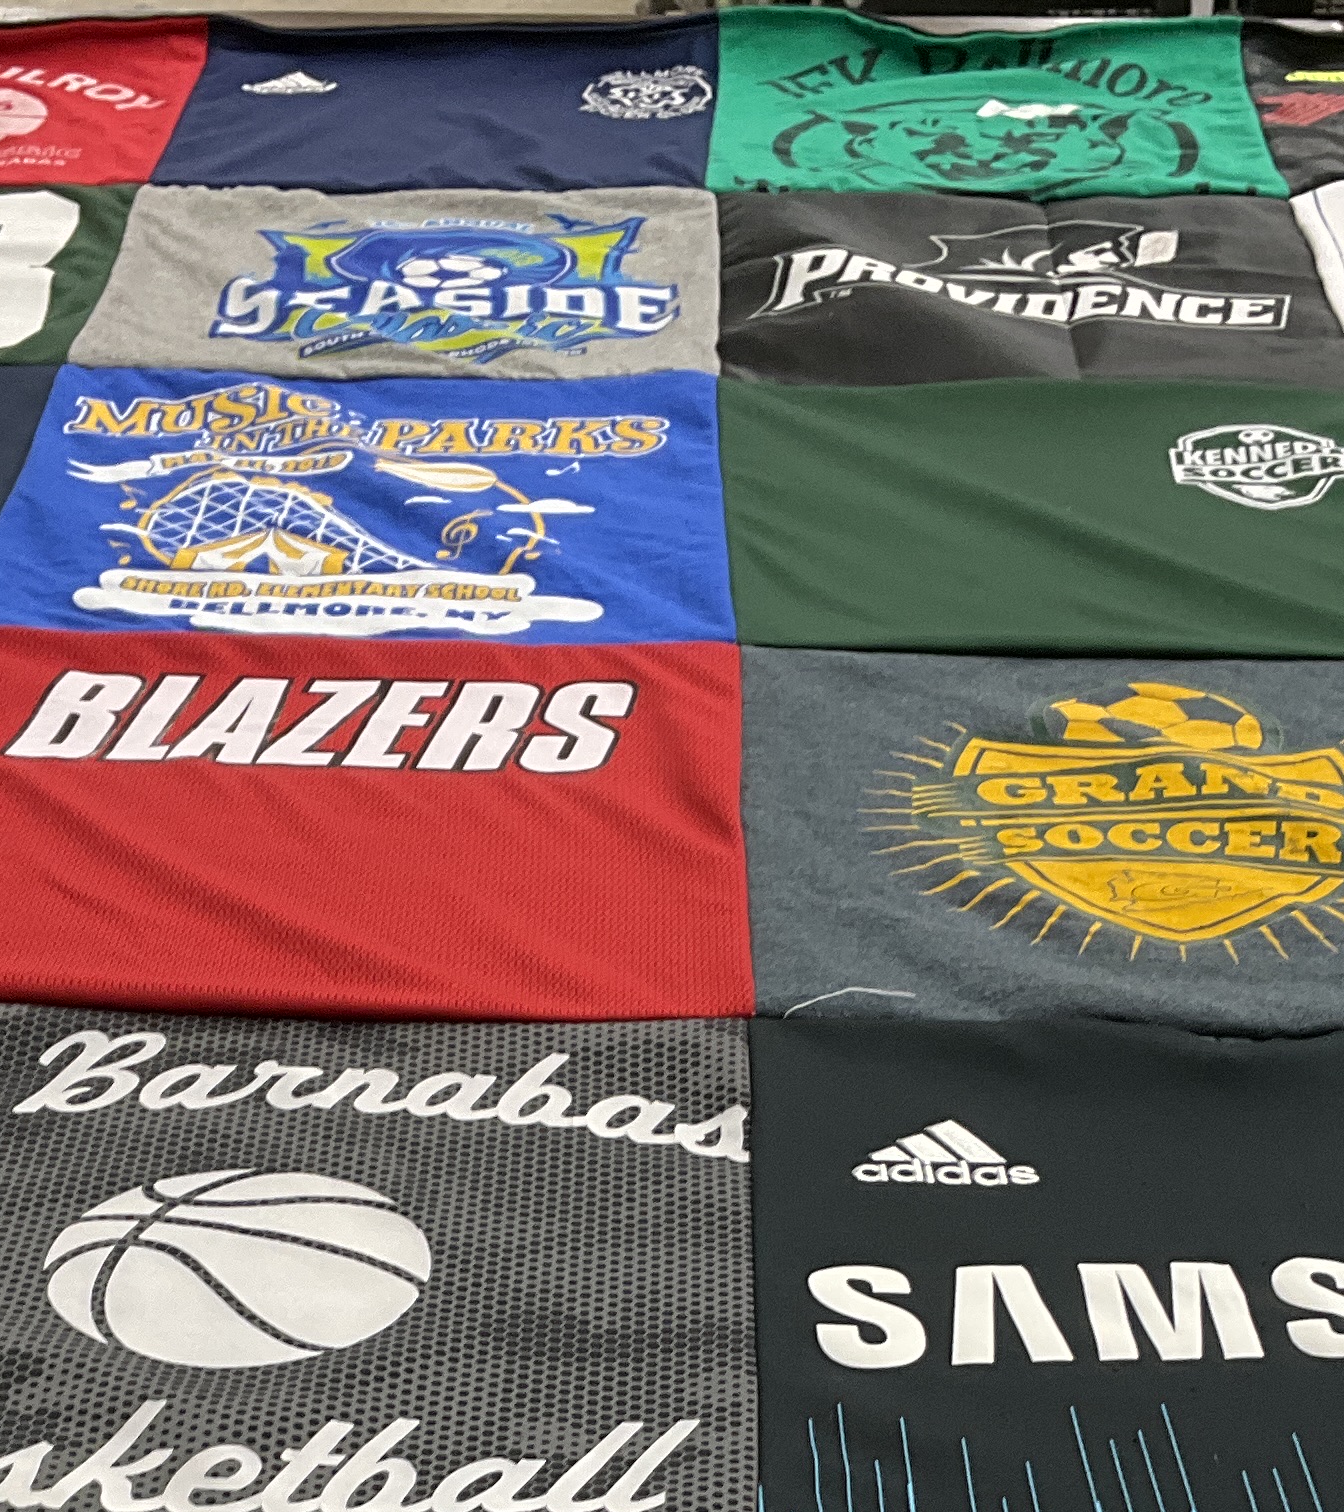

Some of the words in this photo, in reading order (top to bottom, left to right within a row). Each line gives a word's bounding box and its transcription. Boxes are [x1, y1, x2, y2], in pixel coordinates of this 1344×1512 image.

[212, 276, 682, 338] SEASIDE
[778, 248, 1281, 324] PROVIDENCE
[64, 384, 342, 438] MUSIC
[364, 416, 670, 457] PARKS
[1182, 440, 1336, 466] KENNED
[255, 579, 421, 599] ELEMENTARY
[423, 582, 522, 602] SCHOOL
[1, 669, 638, 774] BLAZERS
[996, 820, 1343, 864] SOCCER
[11, 1029, 751, 1164] Barnabas
[851, 1156, 1042, 1187] adidas
